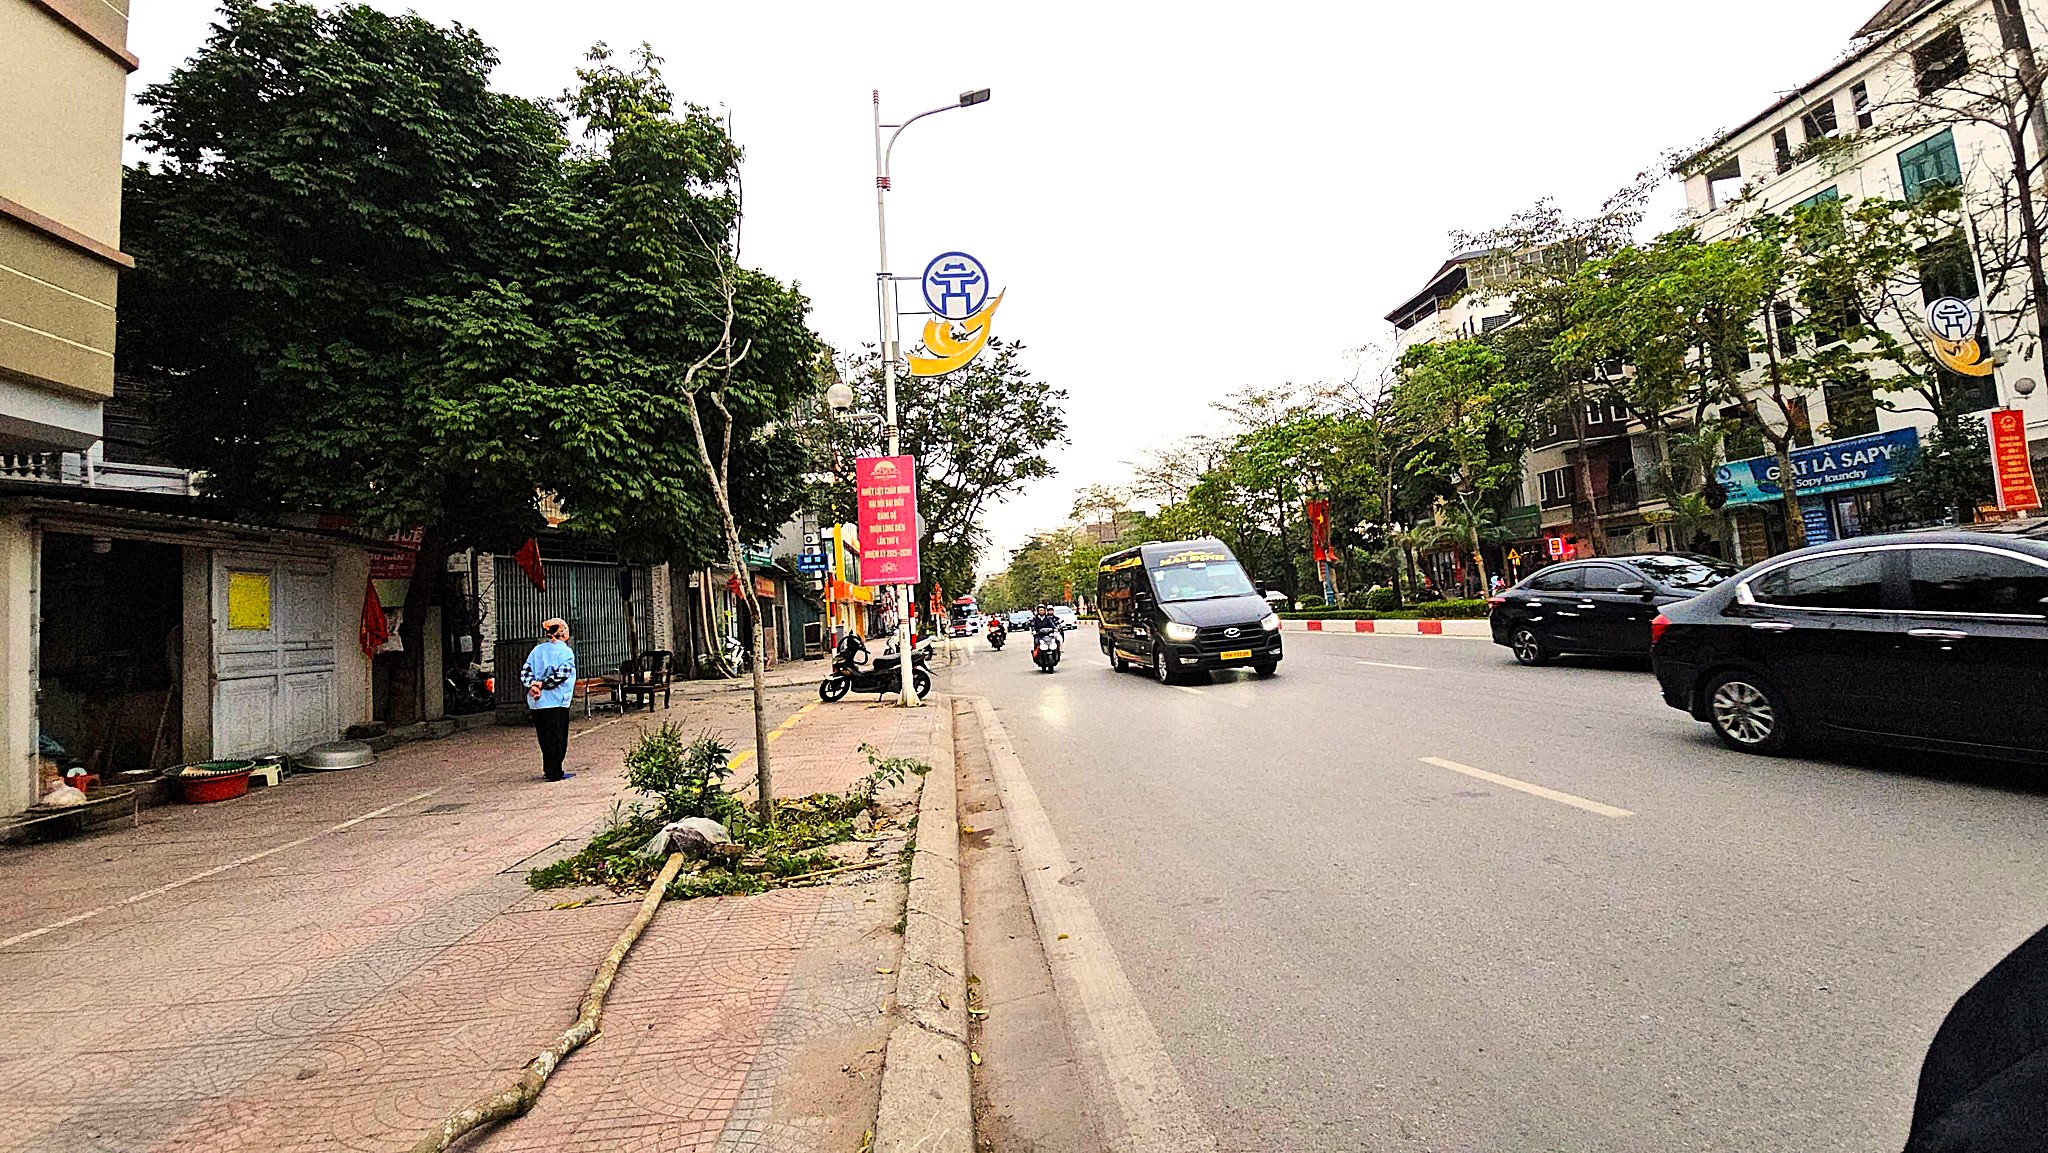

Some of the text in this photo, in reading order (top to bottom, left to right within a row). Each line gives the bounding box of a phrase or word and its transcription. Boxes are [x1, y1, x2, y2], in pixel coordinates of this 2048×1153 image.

[1812, 452, 1838, 473] LÀ
[1840, 443, 1893, 468] SAPY
[1796, 475, 1823, 488] Sapy
[1825, 469, 1868, 484] laundry
